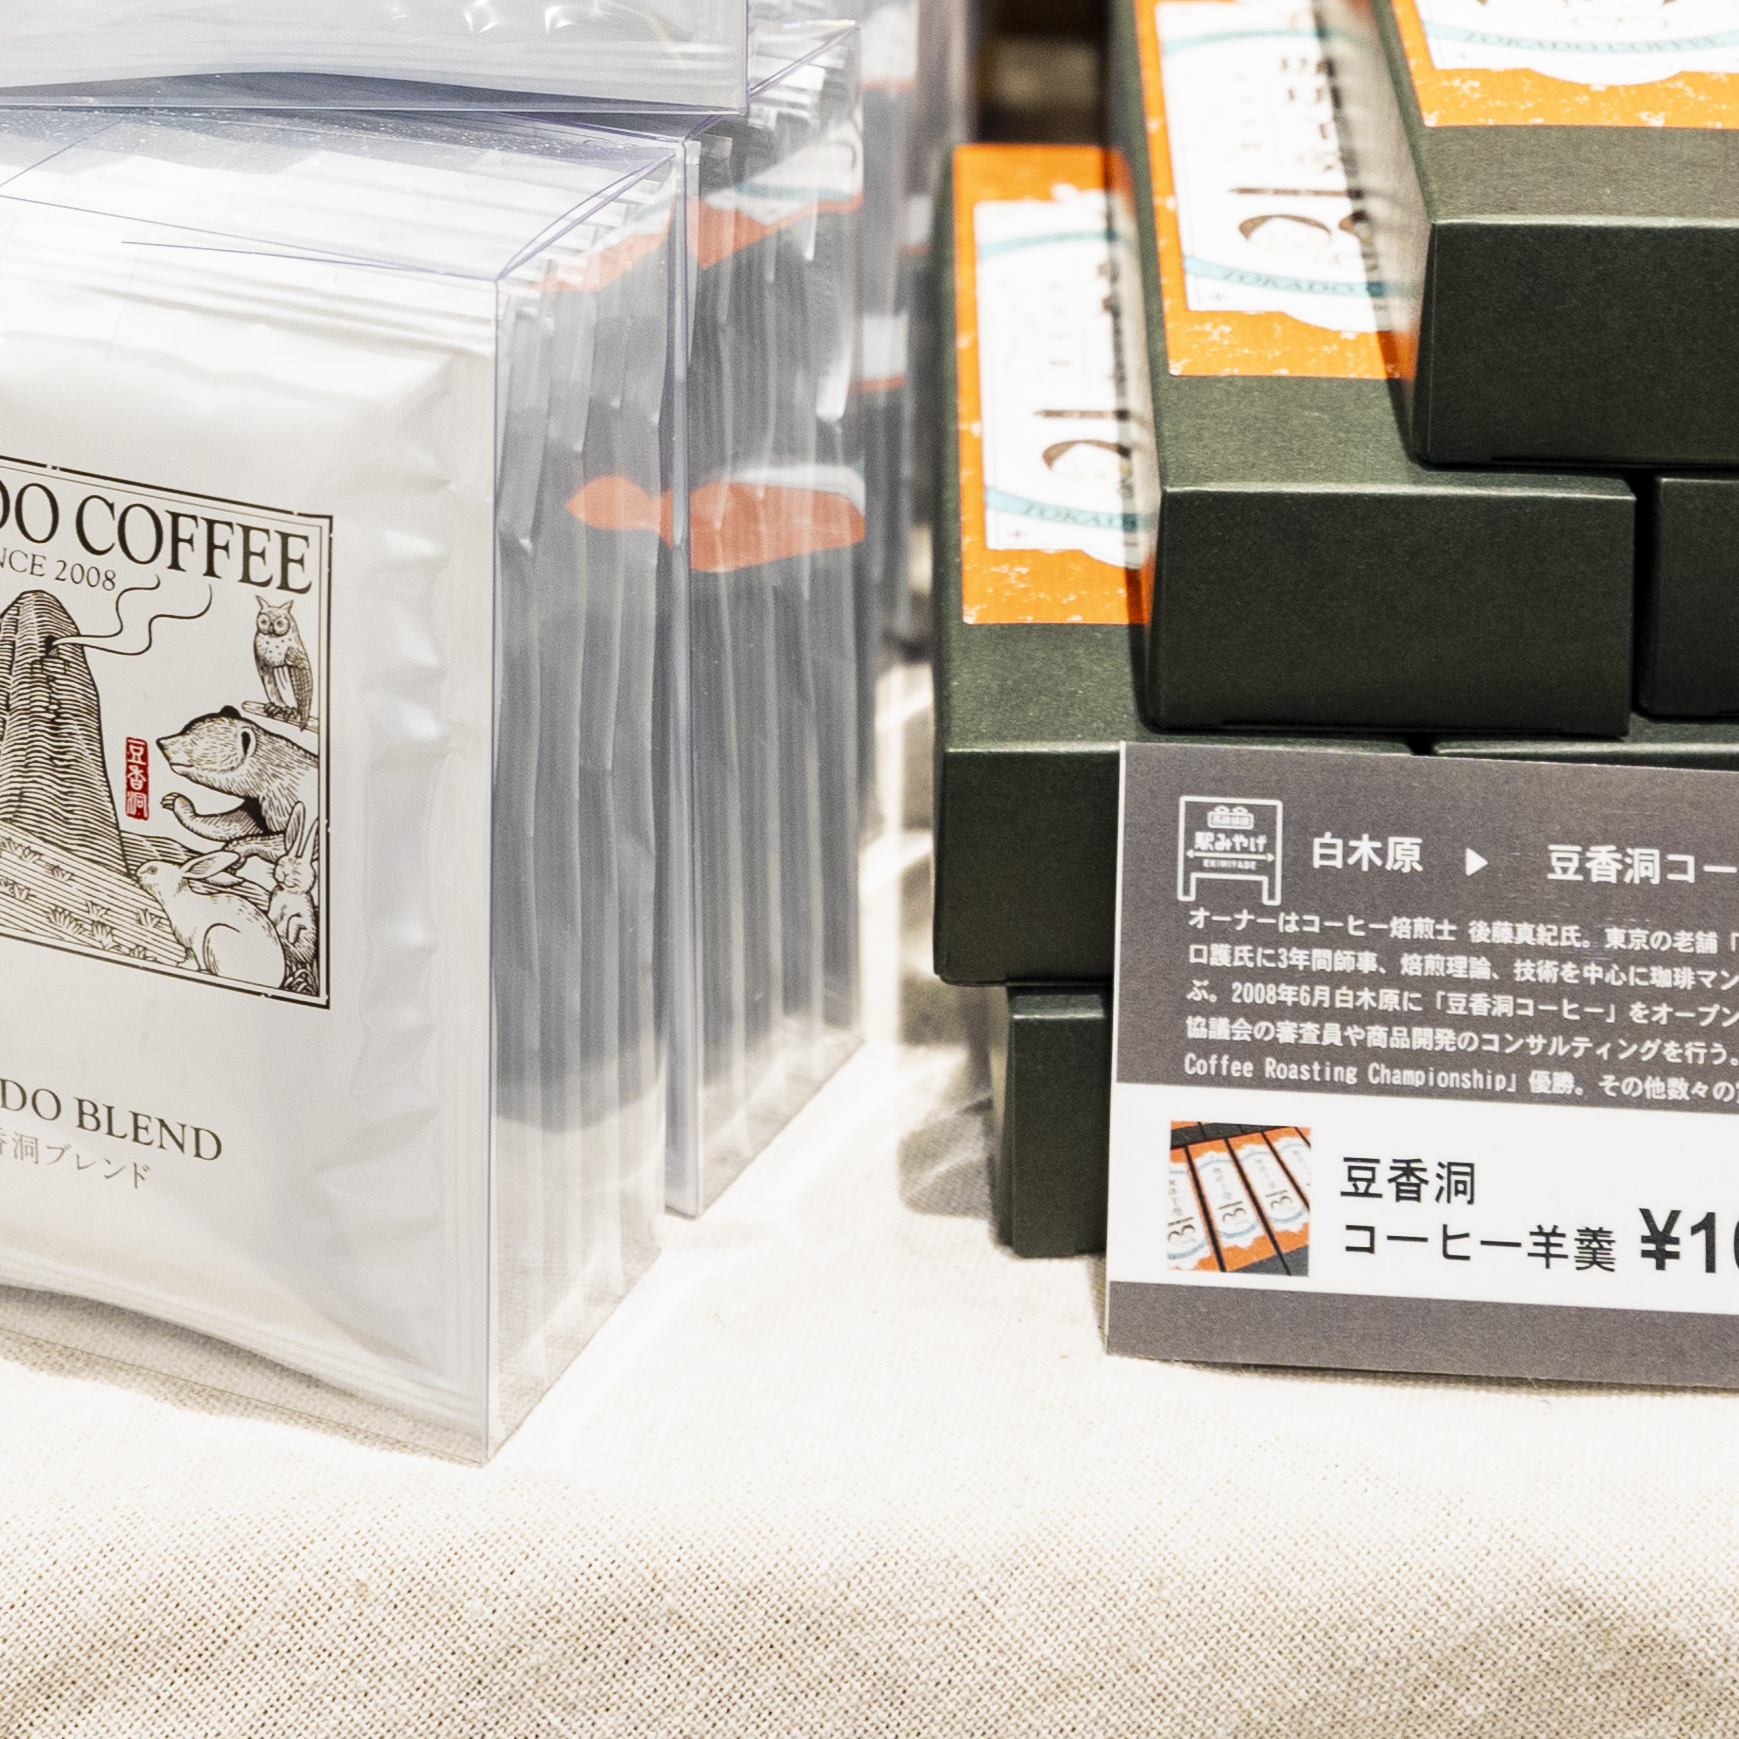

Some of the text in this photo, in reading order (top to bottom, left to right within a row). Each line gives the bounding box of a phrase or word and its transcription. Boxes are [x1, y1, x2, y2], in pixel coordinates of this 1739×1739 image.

[76, 494, 313, 595] COFFEE
[55, 558, 116, 591] 2008
[1312, 836, 1423, 873] 白木原
[1188, 908, 1457, 941] オーナーはコーヒー焙煎士
[1184, 1053, 1254, 1078] Coffee
[1265, 1057, 1358, 1085] Roasting
[76, 1097, 223, 1162] BLEND
[1340, 1154, 1477, 1206] 豆香洞
[1344, 1220, 1617, 1273] コーヒー羊羹
